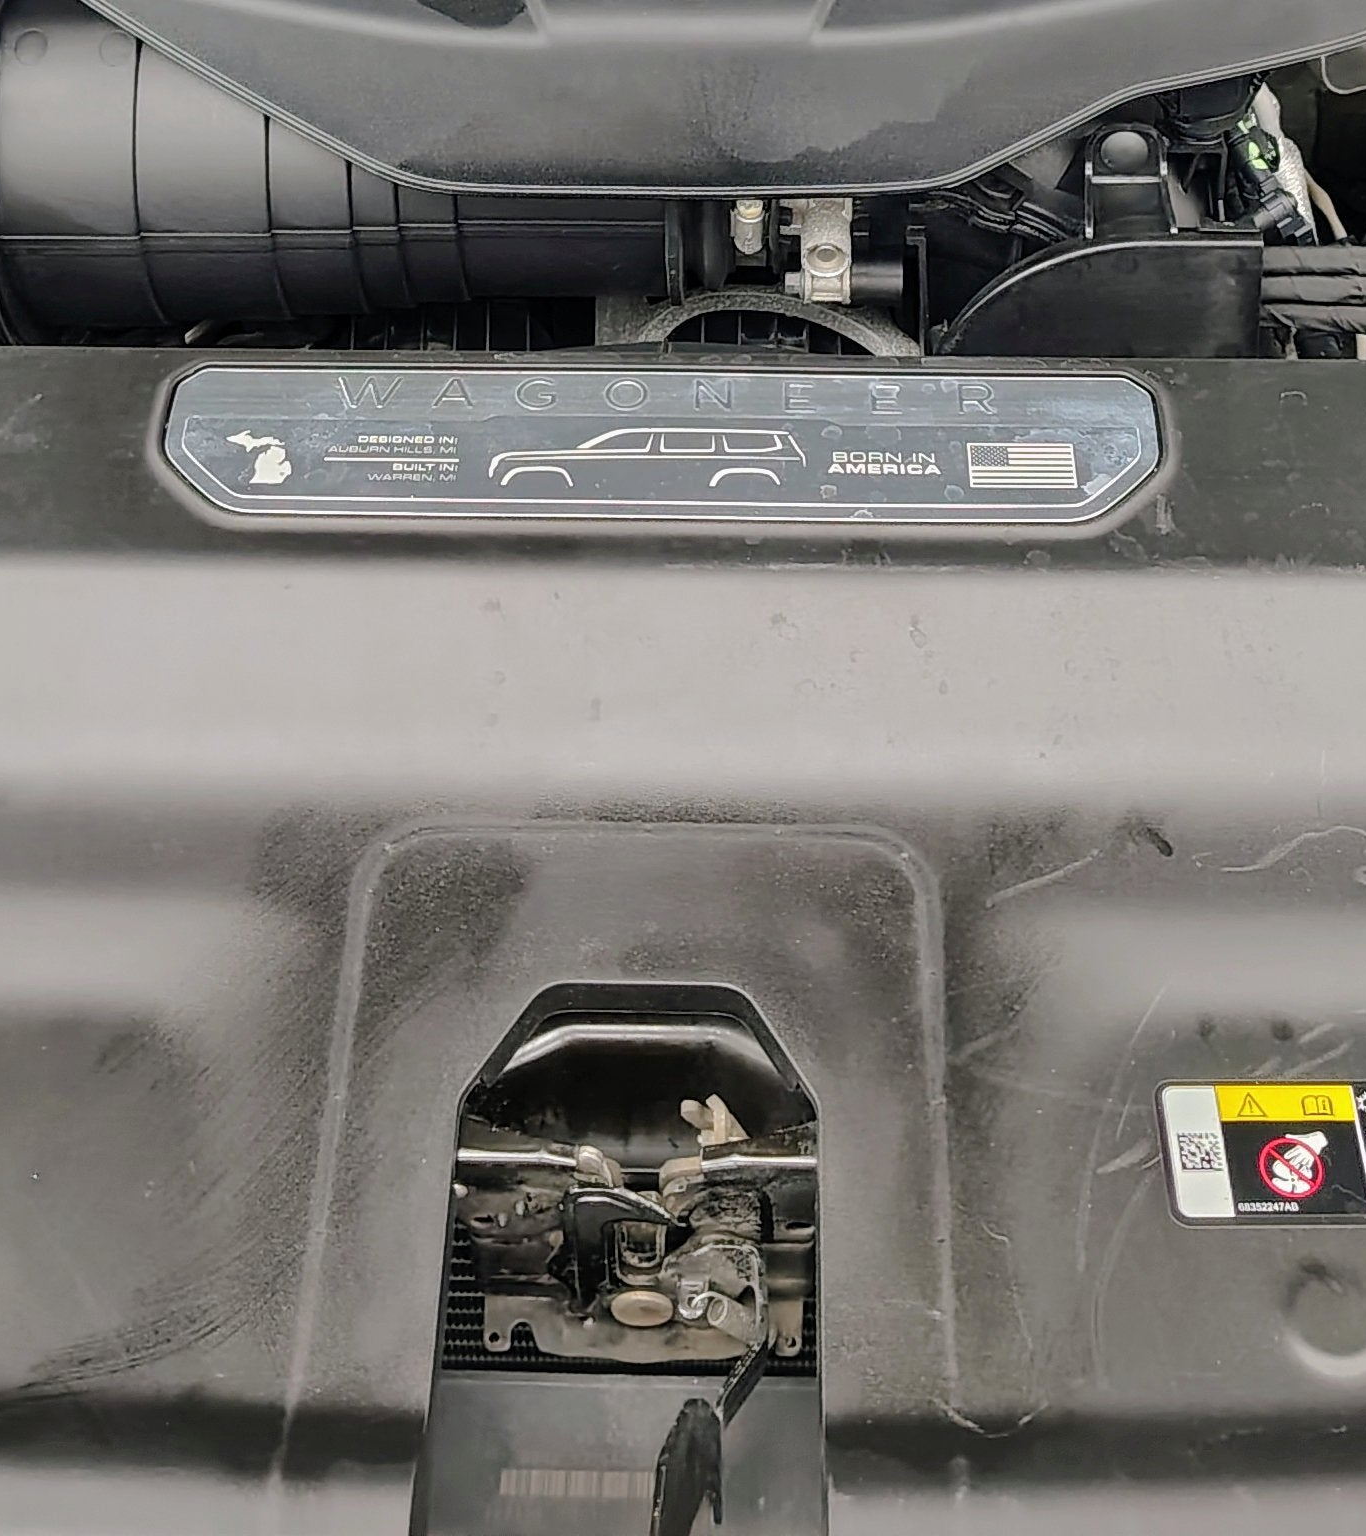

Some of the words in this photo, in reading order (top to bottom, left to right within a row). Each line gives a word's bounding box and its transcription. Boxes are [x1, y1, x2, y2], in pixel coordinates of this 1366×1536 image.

[336, 376, 997, 414] WAGONEER
[357, 435, 435, 444] DESIGNED
[327, 444, 392, 454] AUBURN
[439, 445, 457, 454] MI
[832, 451, 903, 463] BORN
[912, 452, 936, 463] IN
[392, 463, 435, 472] BUILT
[827, 463, 942, 475] AMERICA
[439, 473, 457, 482] MI
